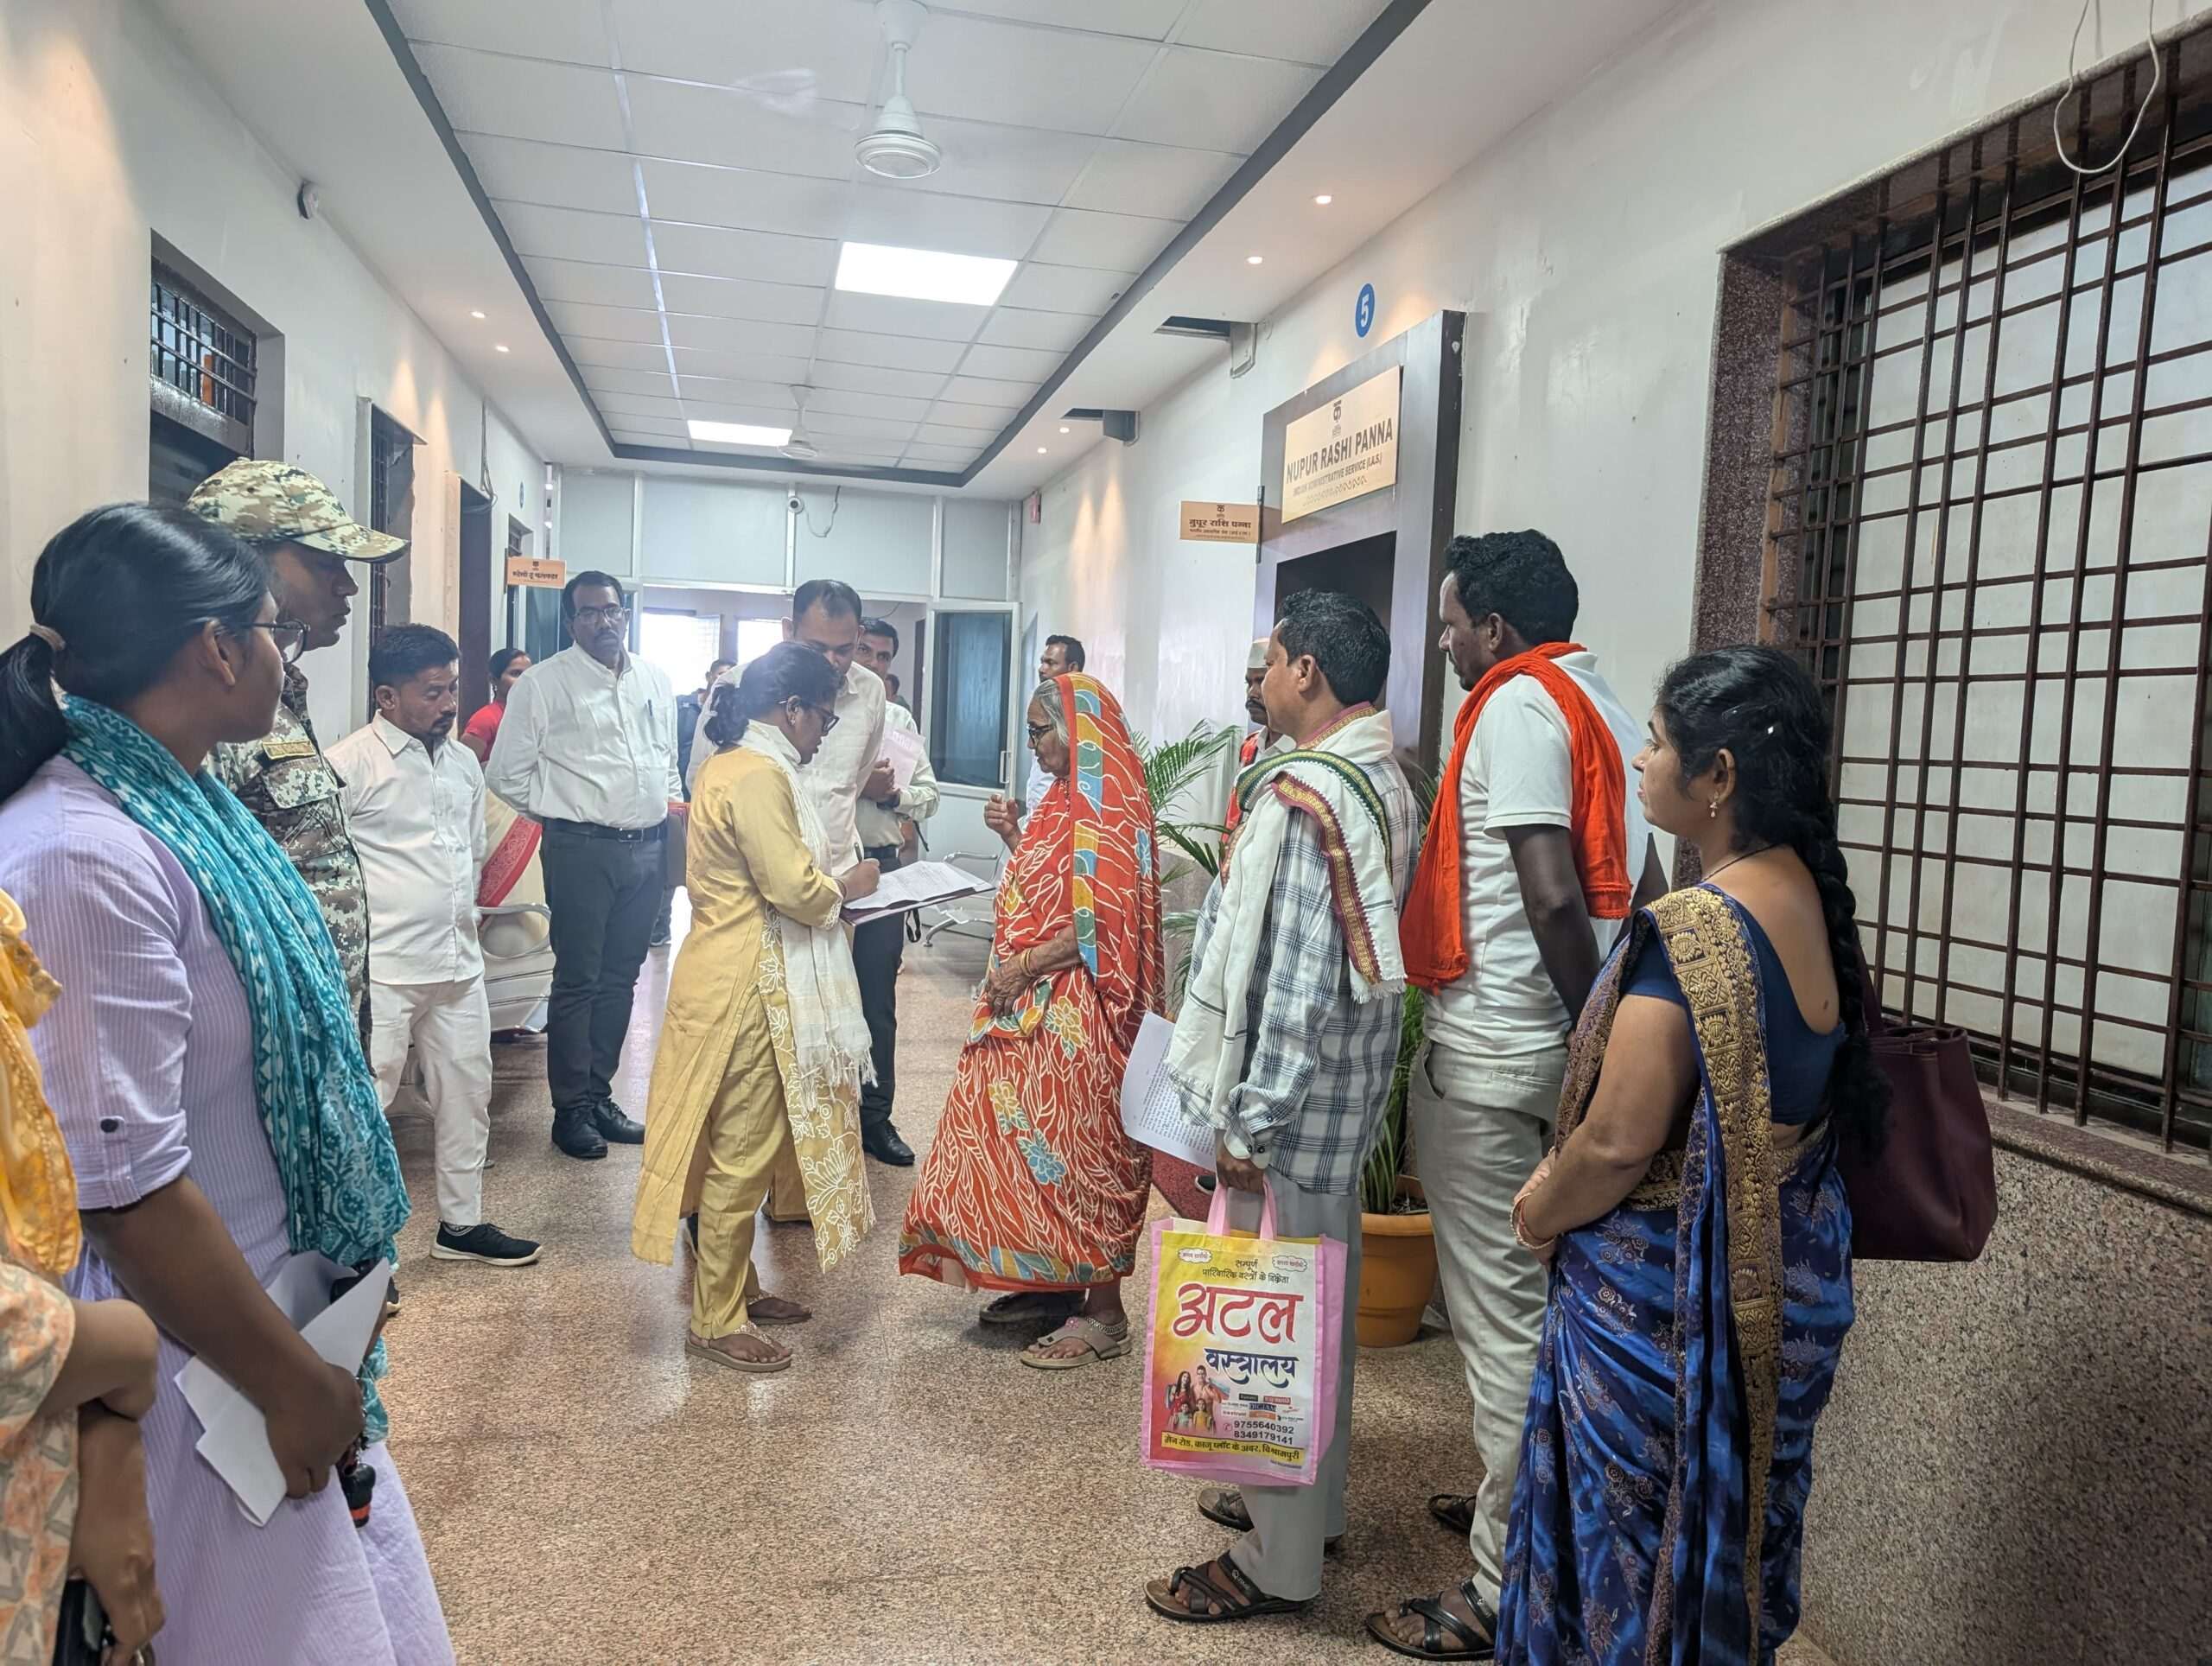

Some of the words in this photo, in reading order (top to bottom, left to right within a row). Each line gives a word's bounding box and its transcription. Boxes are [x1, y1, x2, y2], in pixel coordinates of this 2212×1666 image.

[1361, 294, 1370, 327] 5
[1287, 452, 1318, 484] NUPUR
[1321, 436, 1351, 470] RASHI
[1355, 417, 1393, 455] PANNA
[1345, 460, 1366, 477] SERVICE
[1210, 518, 1229, 527] राशि
[1236, 1259, 1258, 1272] सम्पूर्ण
[1259, 1272, 1266, 1281] के
[1173, 1283, 1304, 1344] अटल
[1205, 1348, 1299, 1389] वस्त्रालय
[1234, 1421, 1294, 1434] 9755640392
[1234, 1431, 1293, 1445] 8349179141
[1232, 1441, 1239, 1450] के
